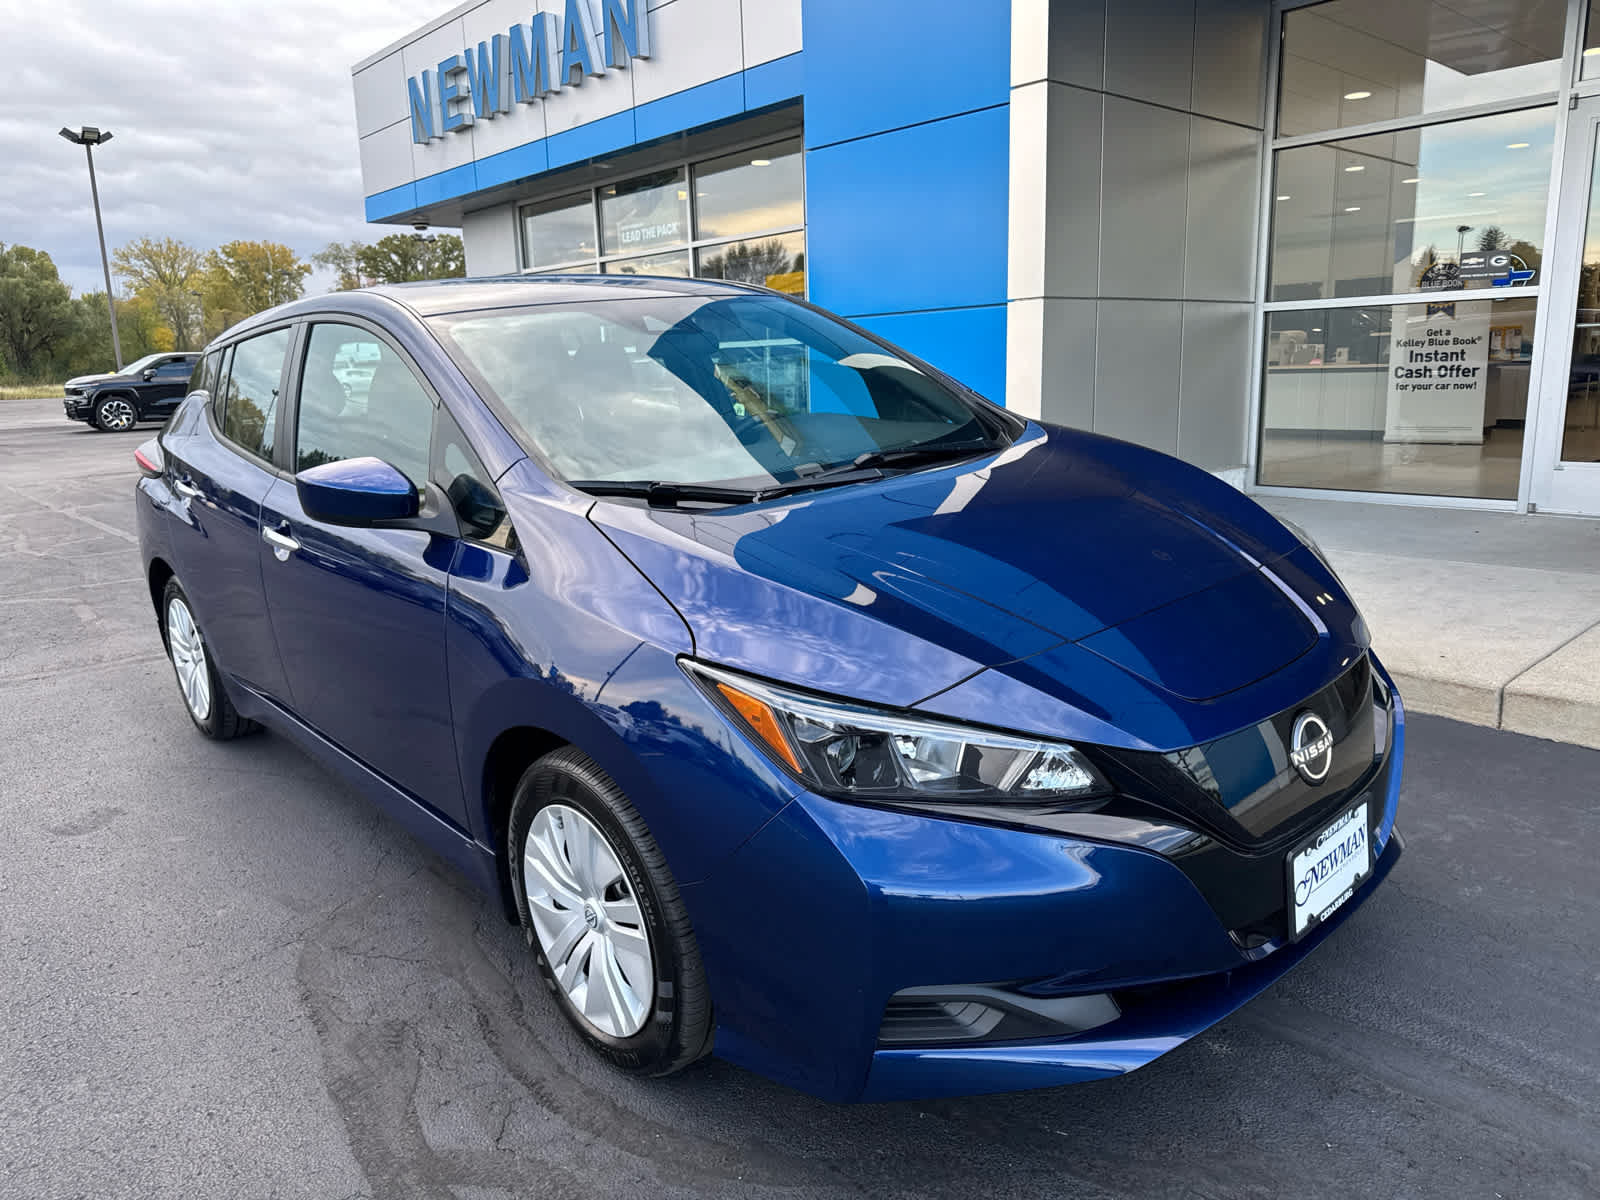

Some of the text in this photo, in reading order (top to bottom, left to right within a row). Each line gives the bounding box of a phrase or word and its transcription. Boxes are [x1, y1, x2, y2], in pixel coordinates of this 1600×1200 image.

[408, 0, 648, 144] NEWMAN
[622, 230, 641, 243] LEAD
[641, 227, 657, 241] THE
[657, 222, 679, 239] PACK
[1421, 281, 1441, 289] BLUE
[1426, 328, 1443, 337] Get
[1396, 338, 1426, 348] Kelley
[1427, 338, 1450, 346] Blue
[1409, 349, 1466, 363] Instant
[1394, 364, 1481, 379] Cash Offer
[1396, 382, 1410, 391] for
[1411, 383, 1433, 392] your
[1453, 381, 1477, 390] now!
[1292, 729, 1334, 766] NISSAN
[1295, 823, 1367, 908] NEWMAN
